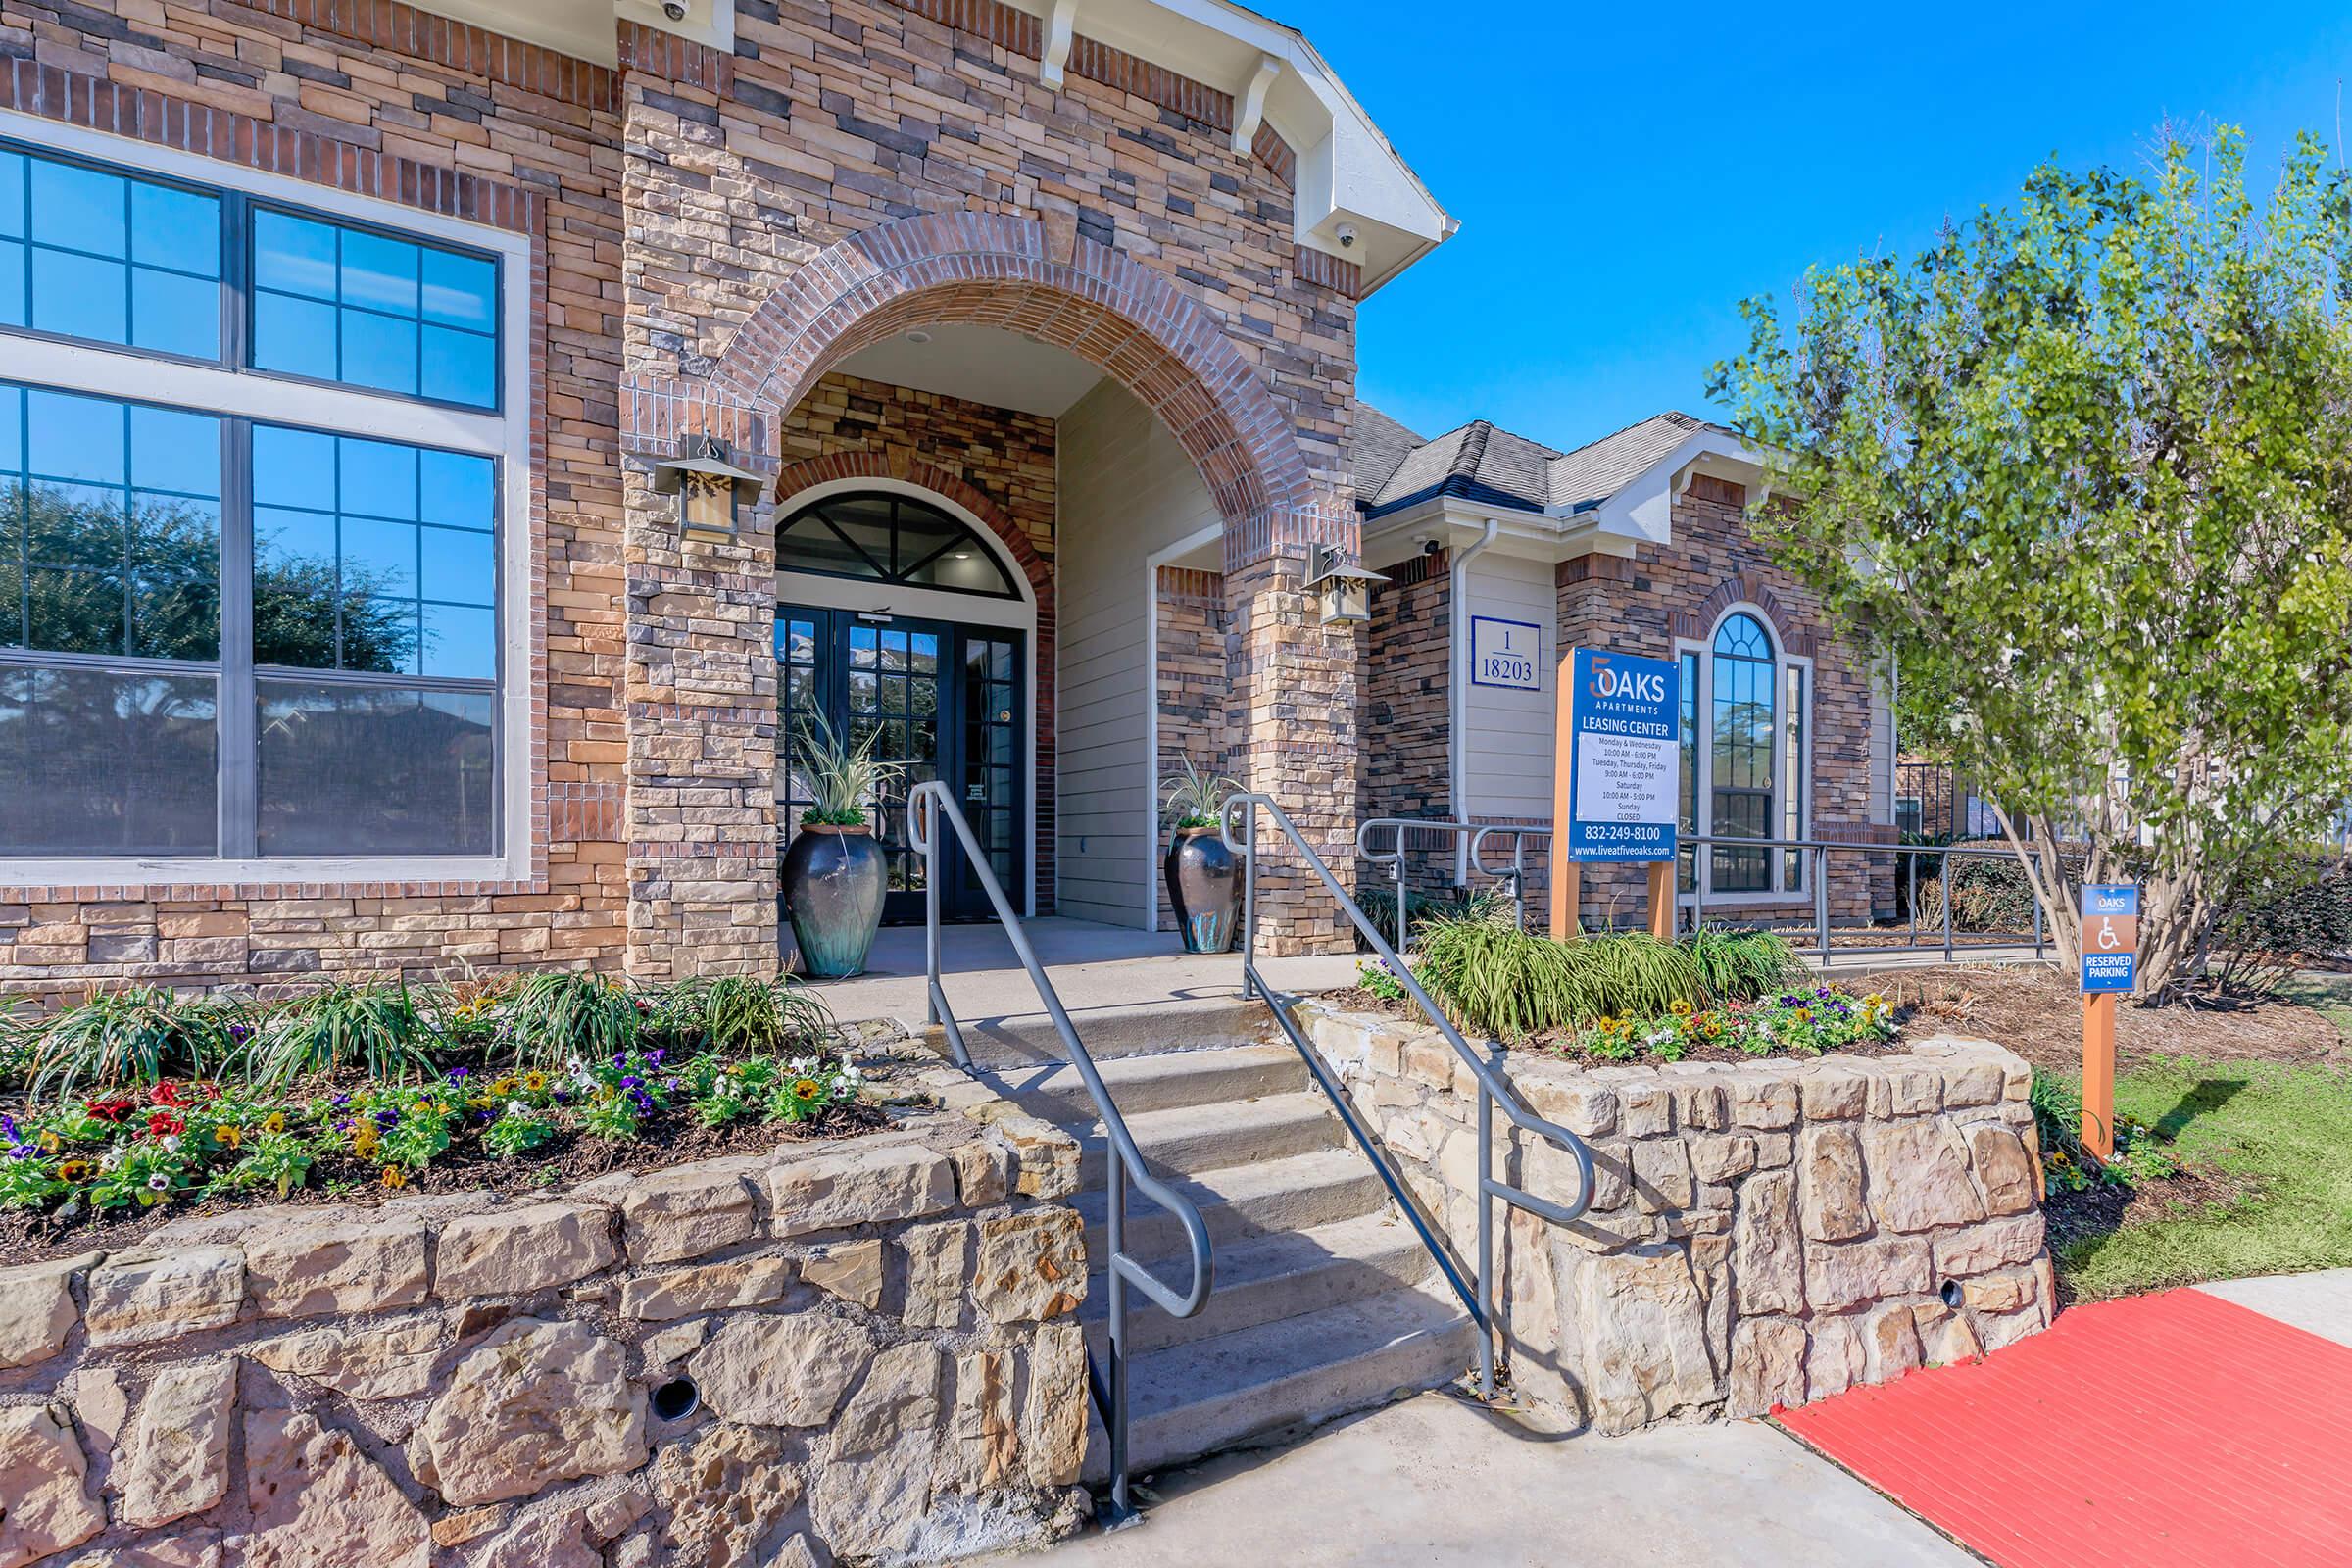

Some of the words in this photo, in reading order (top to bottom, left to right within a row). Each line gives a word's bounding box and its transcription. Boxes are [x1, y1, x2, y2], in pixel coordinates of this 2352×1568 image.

[1504, 630, 1510, 650] 1
[1483, 658, 1532, 681] 18203
[1598, 668, 1665, 703] OAKS
[1595, 701, 1658, 715] APARTMENTS
[1583, 716, 1627, 733] LEASING
[1629, 720, 1669, 737] CENTER
[1598, 737, 1622, 749] Monday
[1629, 740, 1662, 751] Wednesday
[1604, 749, 1620, 758] 10:00
[1592, 758, 1619, 769] Tuesday,
[1620, 760, 1648, 771] Thursday,
[1648, 762, 1667, 772] Friday
[1632, 771, 1644, 780] 6:00
[1616, 781, 1642, 791] Saturday
[1602, 791, 1619, 800] 10:00
[1633, 792, 1645, 801] 5:00
[1618, 802, 1640, 812] Sunday
[1585, 825, 1660, 841] 832-249-8100
[1575, 844, 1669, 856] www.liveatfiveoaks.com
[2098, 897, 2126, 907] OAKS
[2086, 956, 2132, 967] RESERVED
[2088, 966, 2129, 978] PARKING
